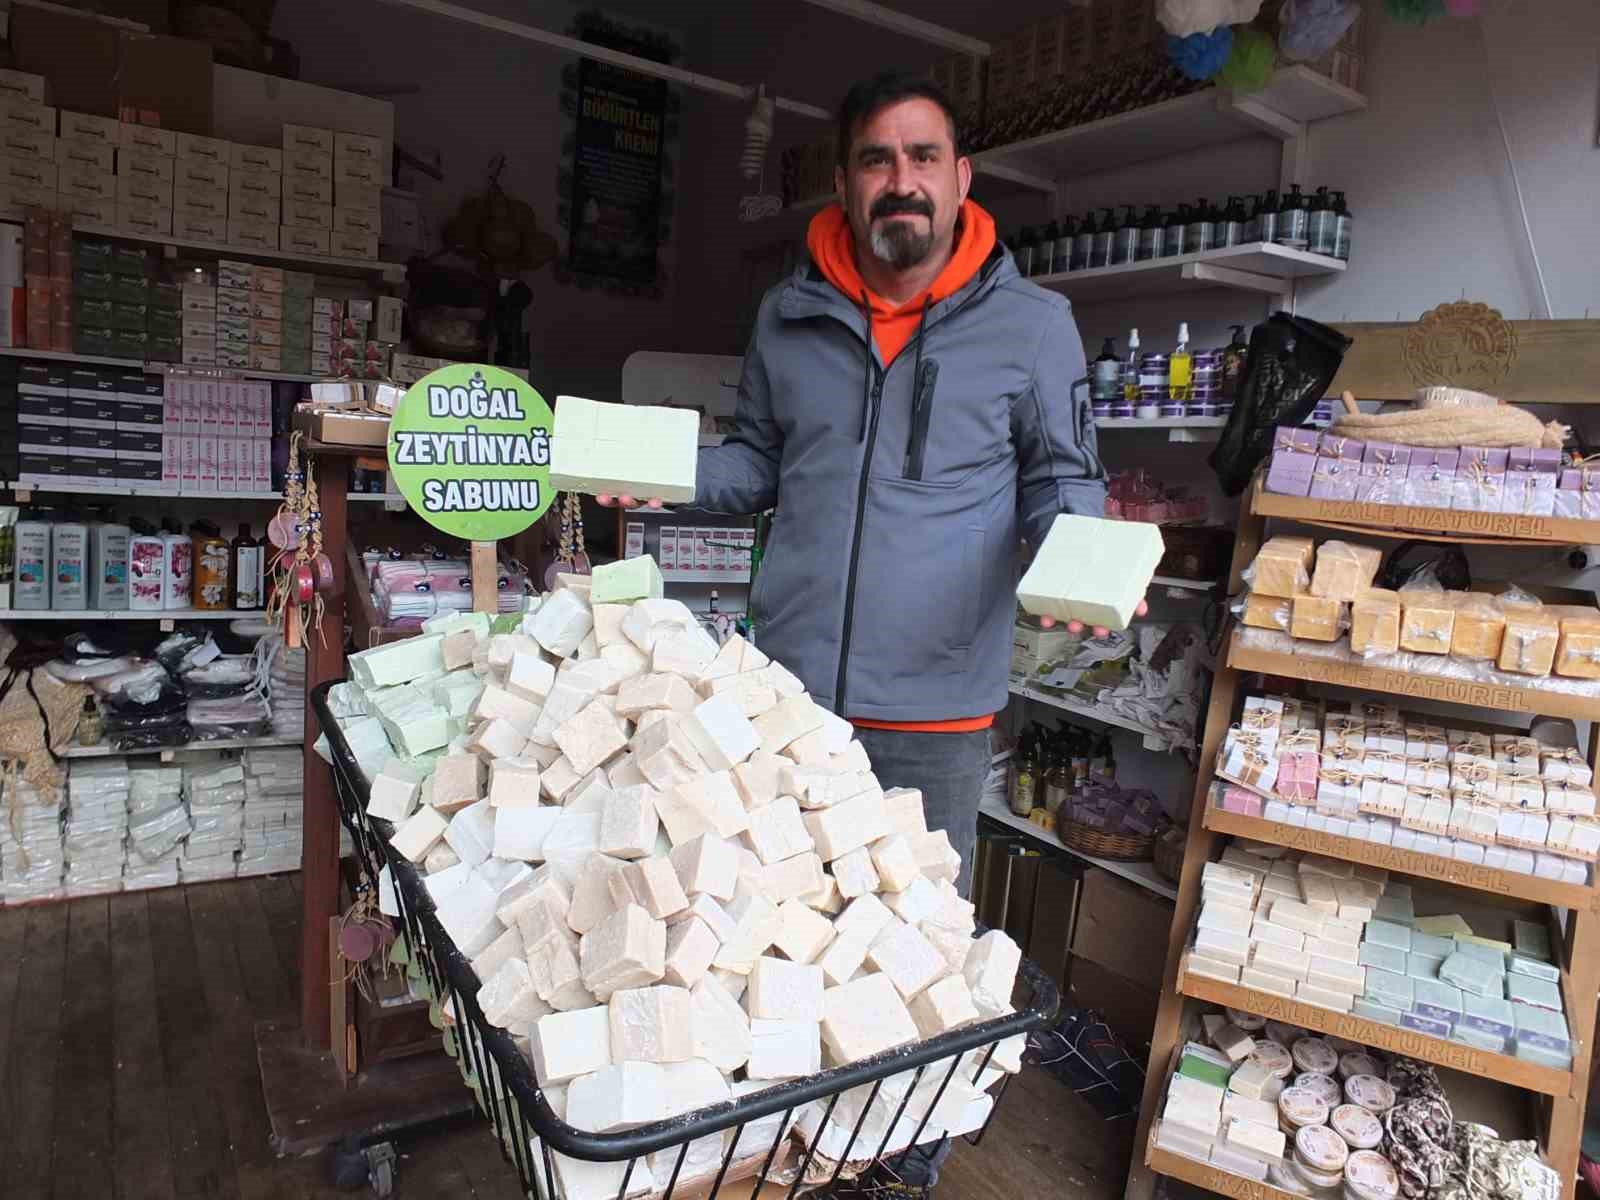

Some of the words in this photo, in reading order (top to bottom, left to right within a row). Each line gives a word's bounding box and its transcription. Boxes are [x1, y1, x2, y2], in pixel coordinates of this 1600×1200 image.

[428, 380, 525, 421] DOĞAL
[395, 426, 552, 465] ZEYTİNYAĞ
[424, 479, 540, 511] SABUNU
[1319, 499, 1394, 521] KALE
[1407, 508, 1552, 536] NATUREL
[1296, 661, 1372, 686] KALE
[1384, 672, 1530, 711] NATUREL
[1273, 824, 1354, 855] KALE
[1361, 843, 1511, 892] NATUREL
[1246, 990, 1326, 1026] KALE
[1334, 1013, 1488, 1073] NATUREL
